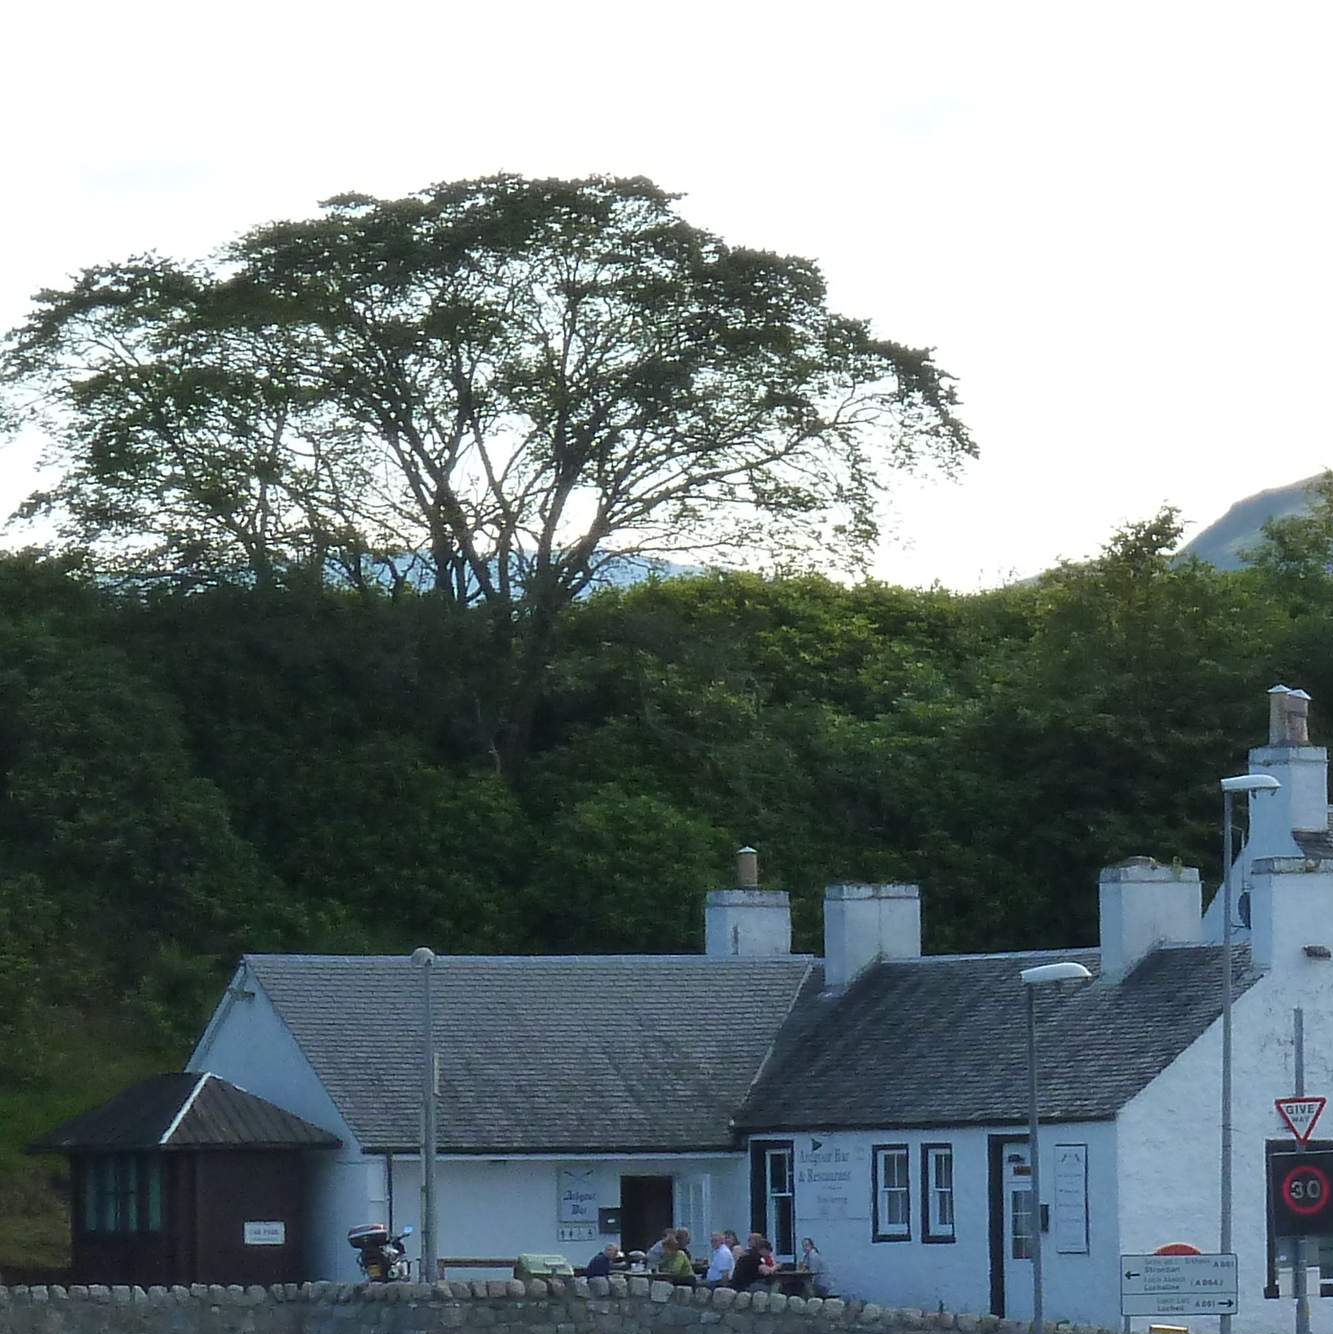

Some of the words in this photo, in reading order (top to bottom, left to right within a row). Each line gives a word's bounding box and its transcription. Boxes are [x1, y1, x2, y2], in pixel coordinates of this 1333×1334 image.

[1286, 1104, 1315, 1115] GIVE
[1292, 1115, 1310, 1123] WAY
[1290, 1179, 1322, 1200] 30
